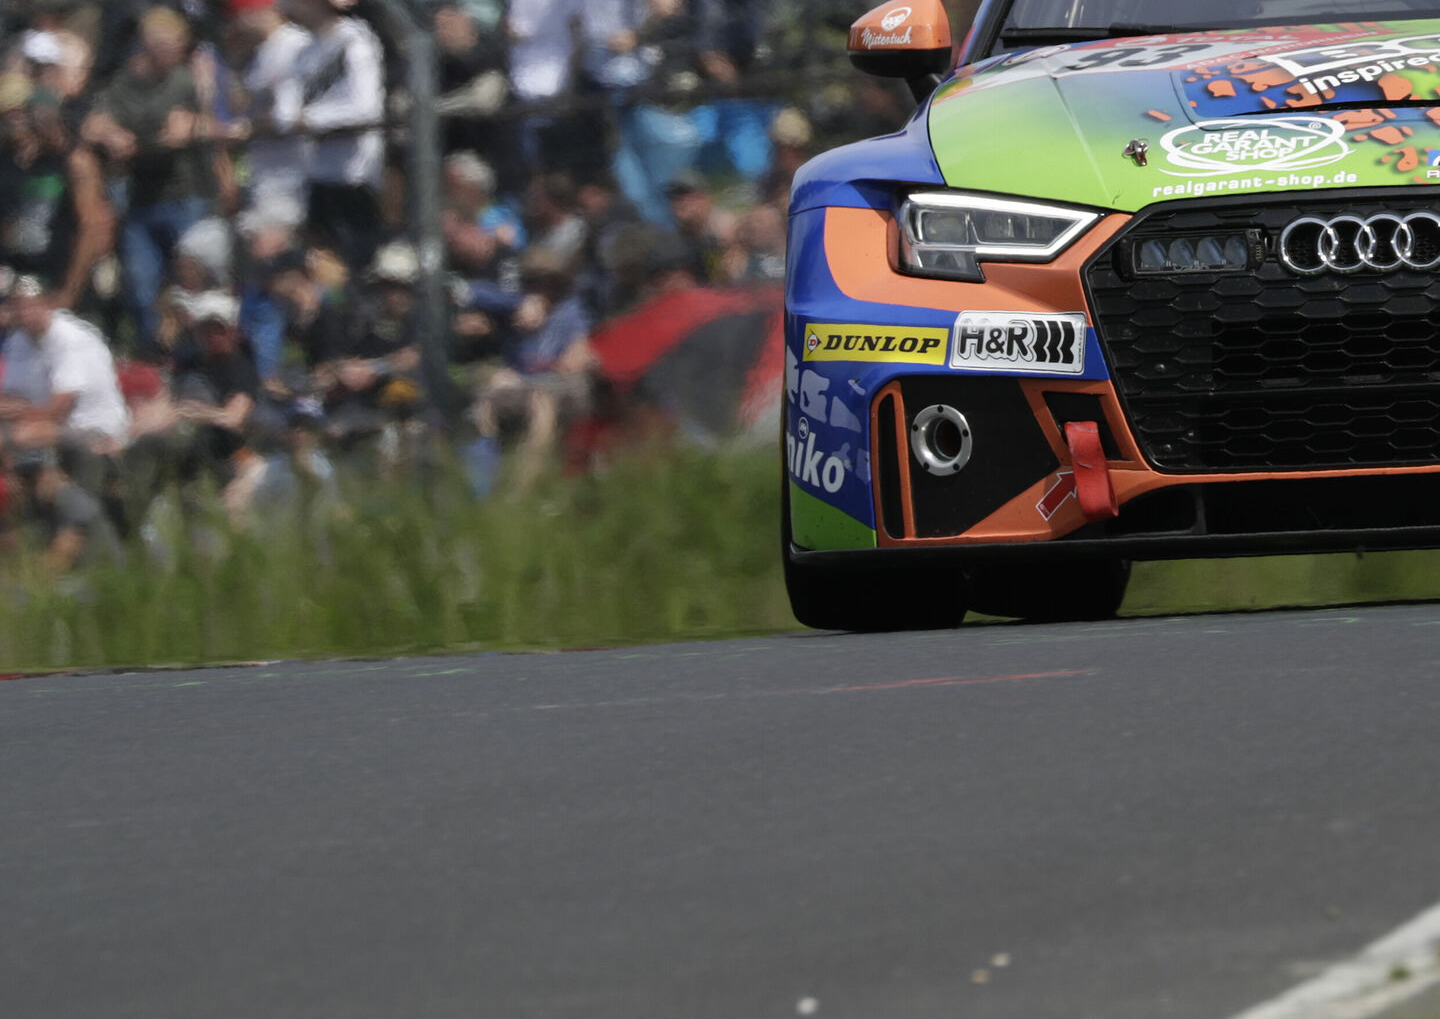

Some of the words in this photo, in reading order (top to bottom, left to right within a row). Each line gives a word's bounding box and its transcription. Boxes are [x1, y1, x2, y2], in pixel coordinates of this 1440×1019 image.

[1066, 42, 1214, 72] 93
[1190, 136, 1318, 155] GARANT
[1202, 130, 1281, 144] REAL
[1225, 147, 1294, 162] SHOP
[1152, 170, 1358, 197] realgarant-shop.de
[823, 334, 941, 354] DUNLOP
[958, 324, 1029, 358] H&R
